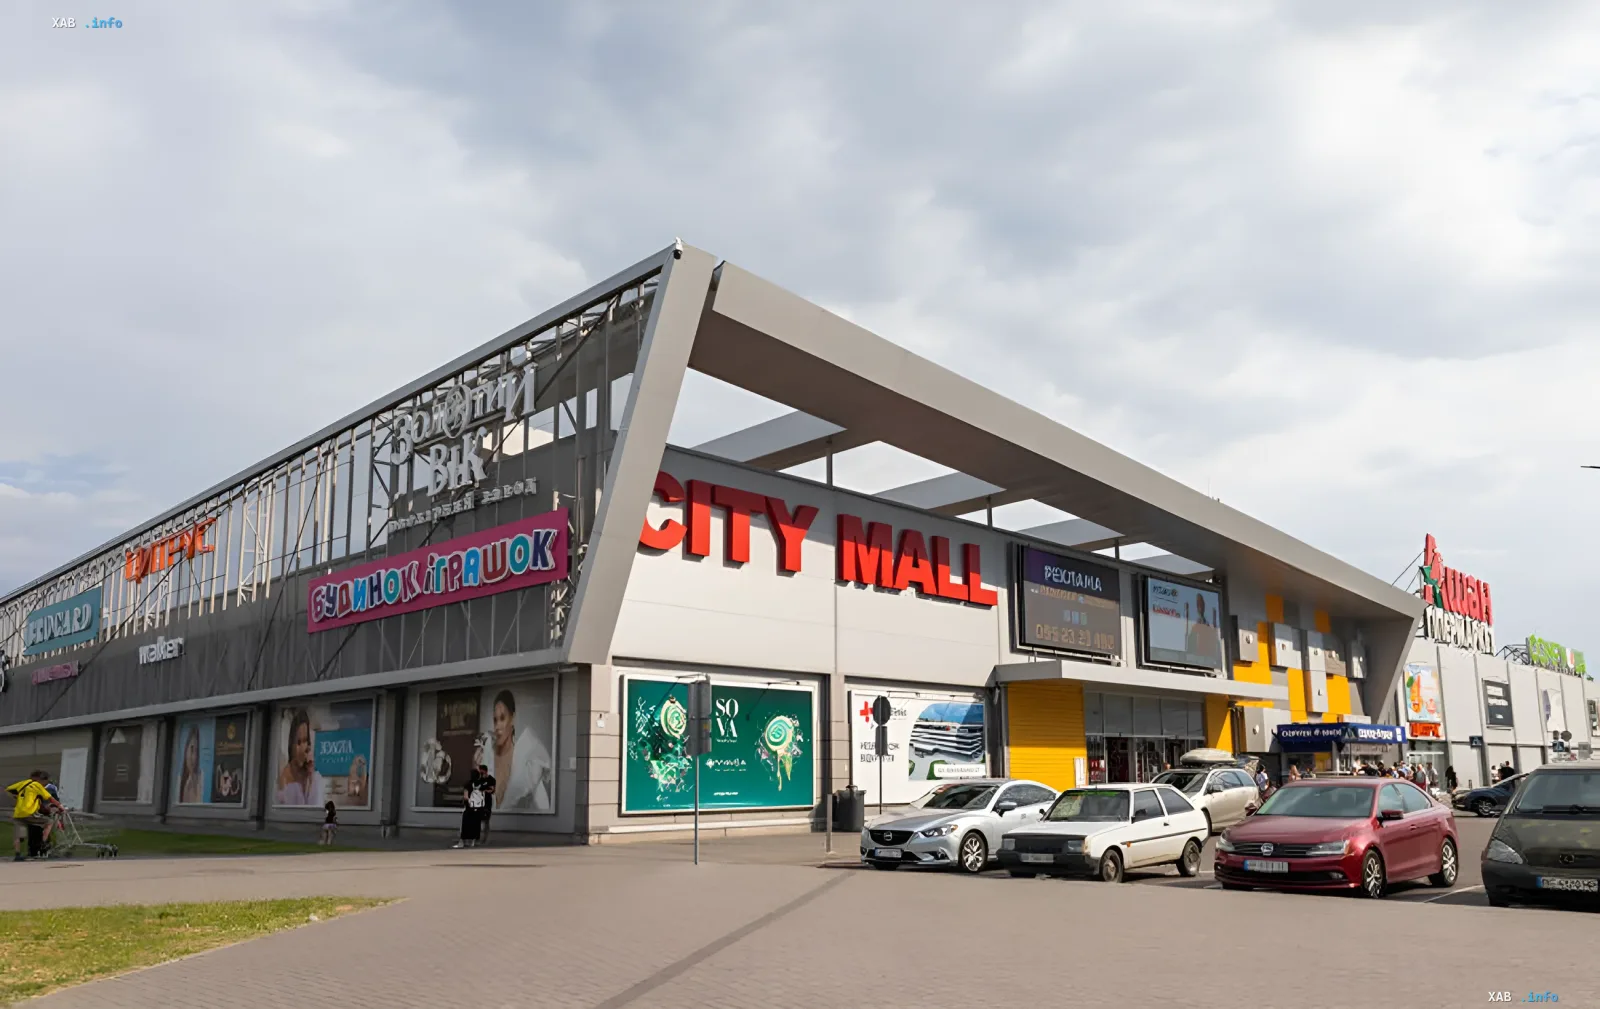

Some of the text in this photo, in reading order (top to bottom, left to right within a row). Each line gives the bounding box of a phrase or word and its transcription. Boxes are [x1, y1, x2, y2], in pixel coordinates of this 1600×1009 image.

[639, 471, 998, 606] CITY MALL
[311, 560, 422, 623] БУДИНОК
